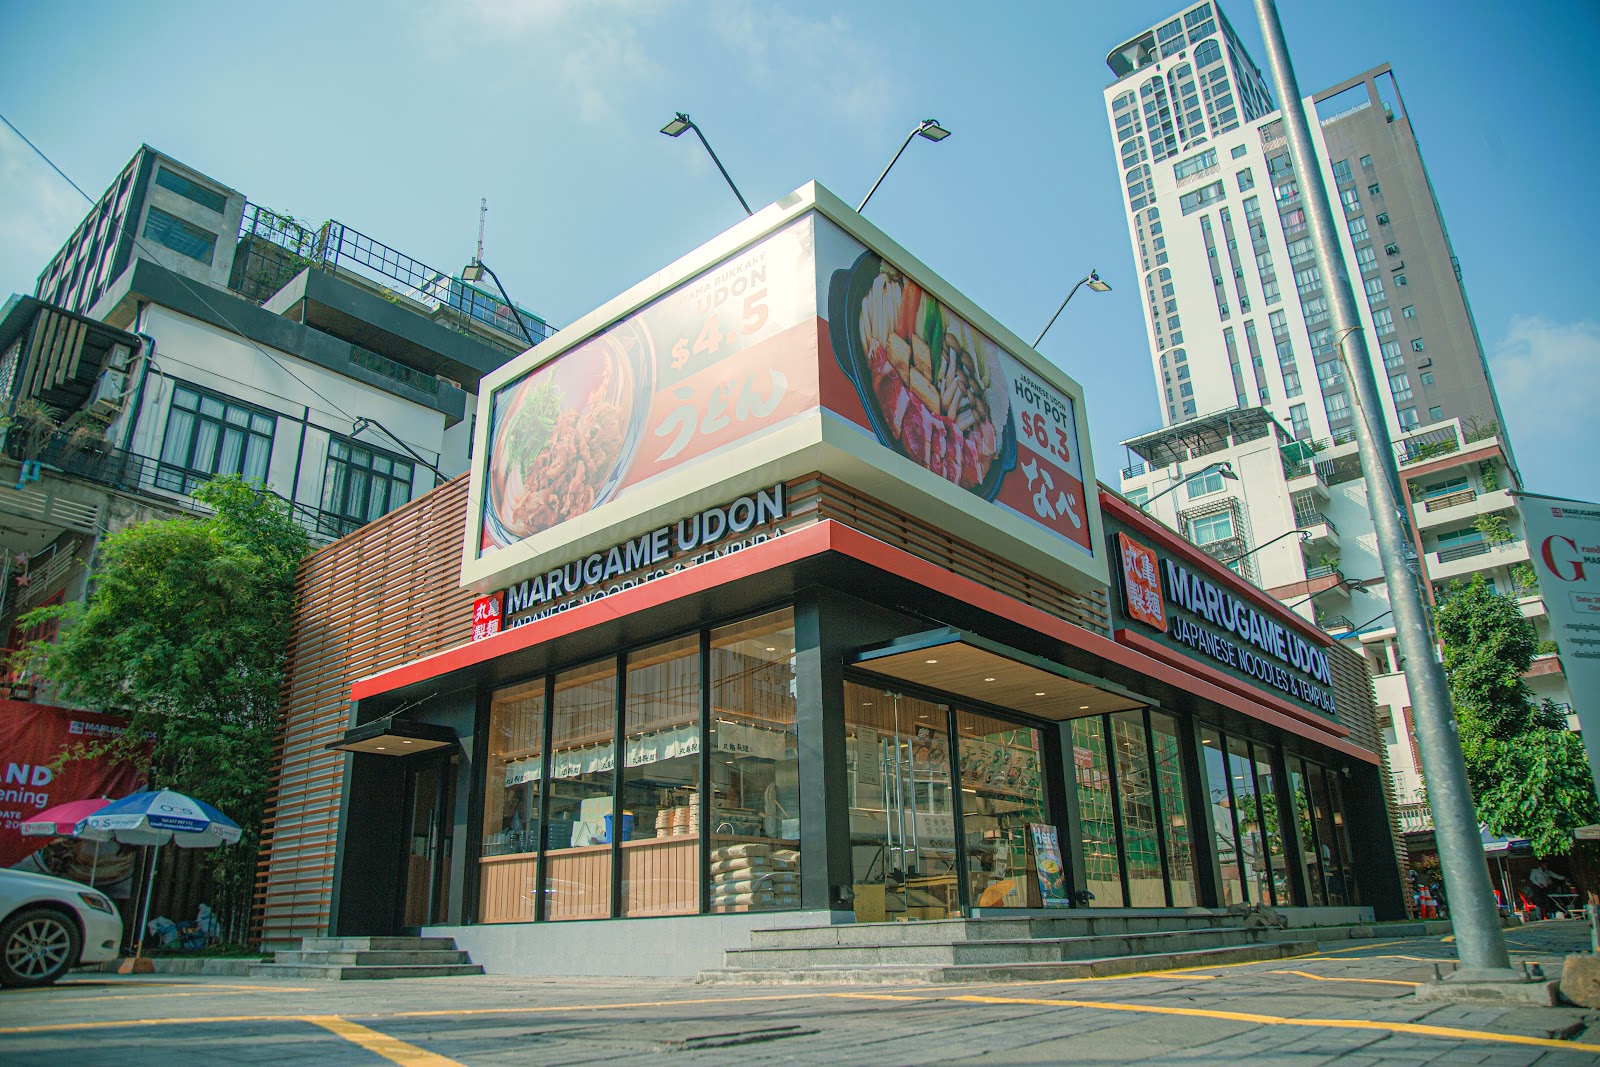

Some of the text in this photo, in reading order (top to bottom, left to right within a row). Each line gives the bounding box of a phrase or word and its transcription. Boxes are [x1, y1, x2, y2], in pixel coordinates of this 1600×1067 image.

[697, 264, 767, 314] UDON
[714, 251, 767, 287] BUKKAKE
[670, 287, 769, 371] $4.5
[654, 368, 788, 463] うどん
[1014, 378, 1068, 429] HOT POT
[1020, 373, 1067, 411] JAPANESE UDON
[1021, 410, 1071, 464] $6.3
[1021, 457, 1082, 529] なべ
[507, 483, 785, 615] MARUGAME UDON
[1165, 558, 1333, 687] MARUGAME UDON
[1172, 615, 1337, 715] JAPANESE NOODLES & TEMPURA
[85, 722, 125, 735] MARUGA
[0, 762, 54, 786] ND
